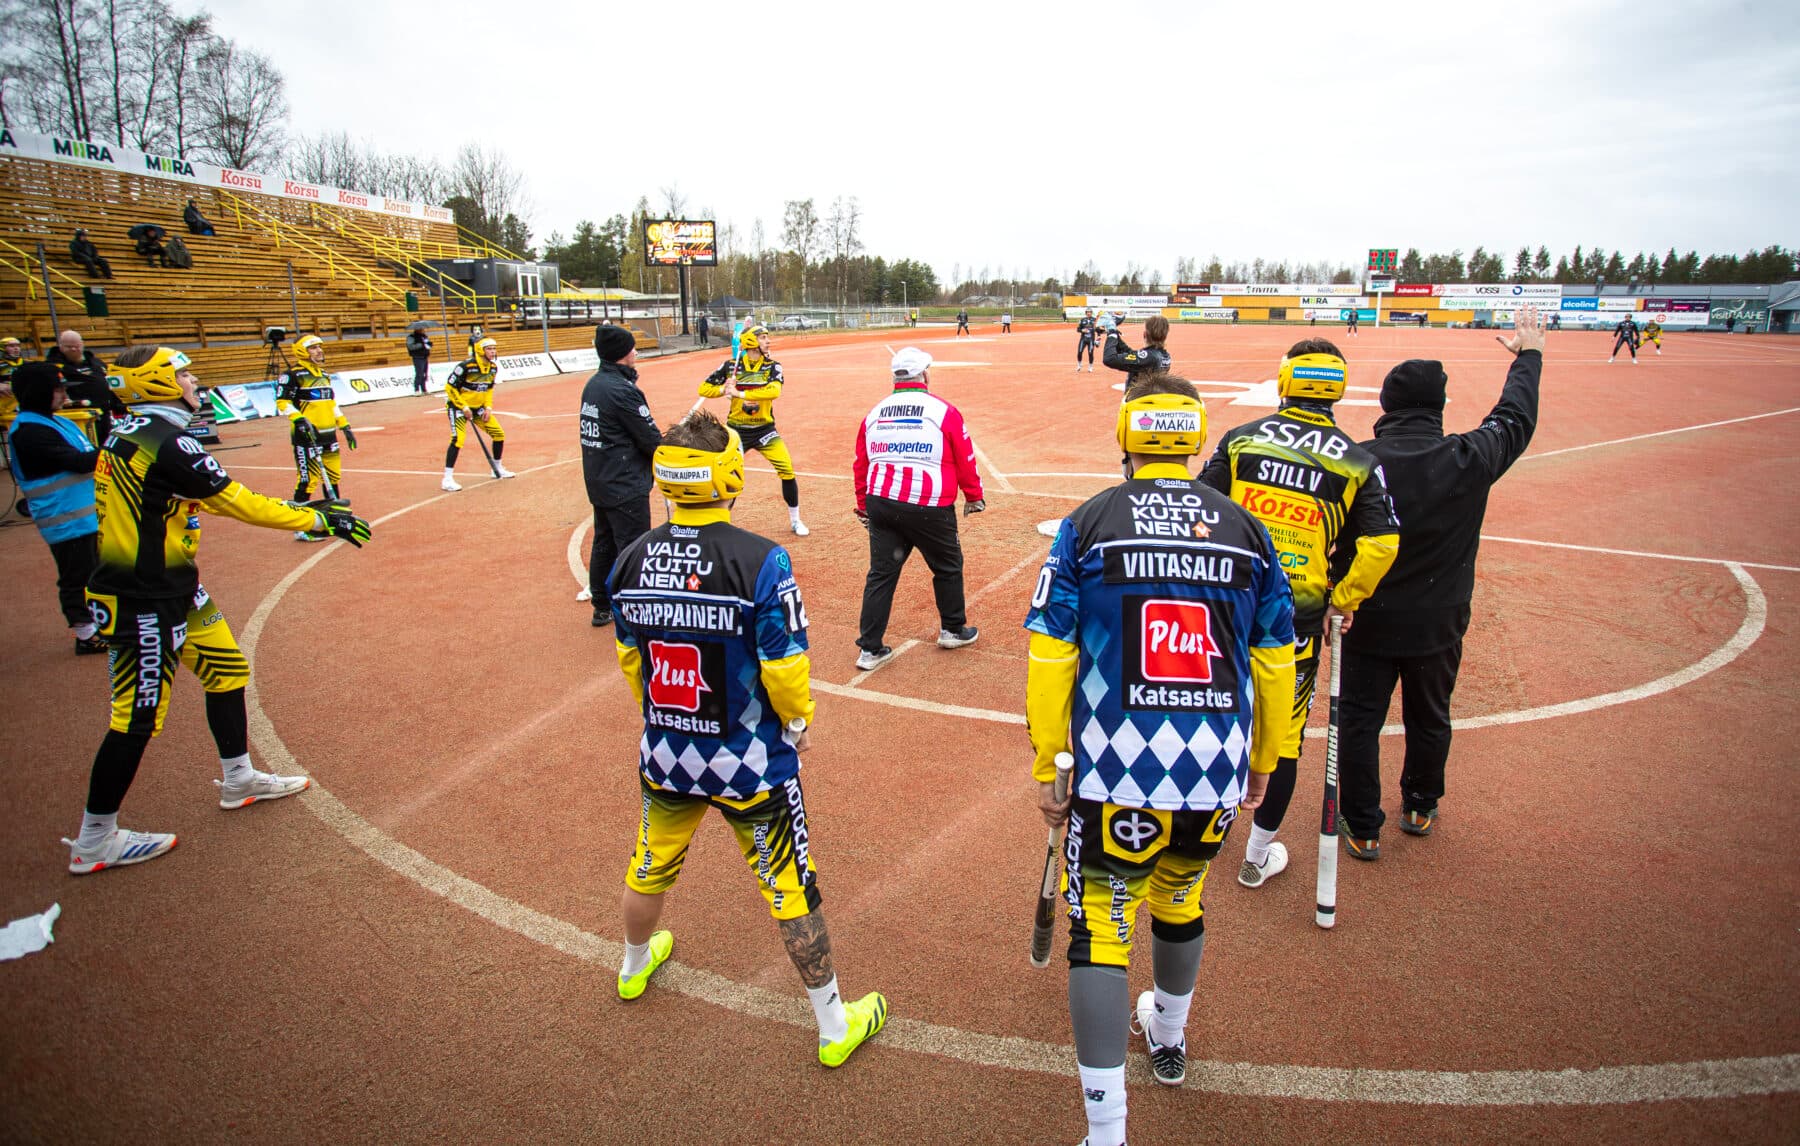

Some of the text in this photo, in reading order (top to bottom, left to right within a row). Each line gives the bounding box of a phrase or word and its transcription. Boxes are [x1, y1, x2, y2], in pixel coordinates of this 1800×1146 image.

[221, 169, 262, 190] Korsu
[284, 180, 319, 198] Korsu
[338, 190, 368, 207] Korsu
[384, 199, 411, 214] Korsu
[423, 205, 449, 220] Korsu
[500, 356, 543, 370] BEIJERS
[879, 404, 924, 418] KIVINIEMI
[580, 419, 600, 438] SAB
[1155, 419, 1196, 431] MAKIA
[870, 441, 933, 455] Autoexperten
[1253, 420, 1350, 461] SSAB
[1257, 459, 1305, 490] STILL
[1128, 492, 1202, 507] VALO
[1240, 487, 1324, 527] Korsu
[1131, 506, 1220, 524] KUITU
[1134, 521, 1191, 538] NEN
[1267, 525, 1299, 538] RHEILU
[647, 542, 701, 558] VALO
[641, 557, 713, 576] KUITU
[1122, 552, 1234, 584] VIITASALO
[639, 573, 685, 589] NEN
[621, 600, 735, 632] KEMPPAINEN
[1149, 619, 1205, 655] Plus
[652, 656, 697, 688] Plus
[1129, 684, 1233, 709] Katsastus
[649, 705, 721, 734] atsastus
[1326, 723, 1338, 788] KARHU
